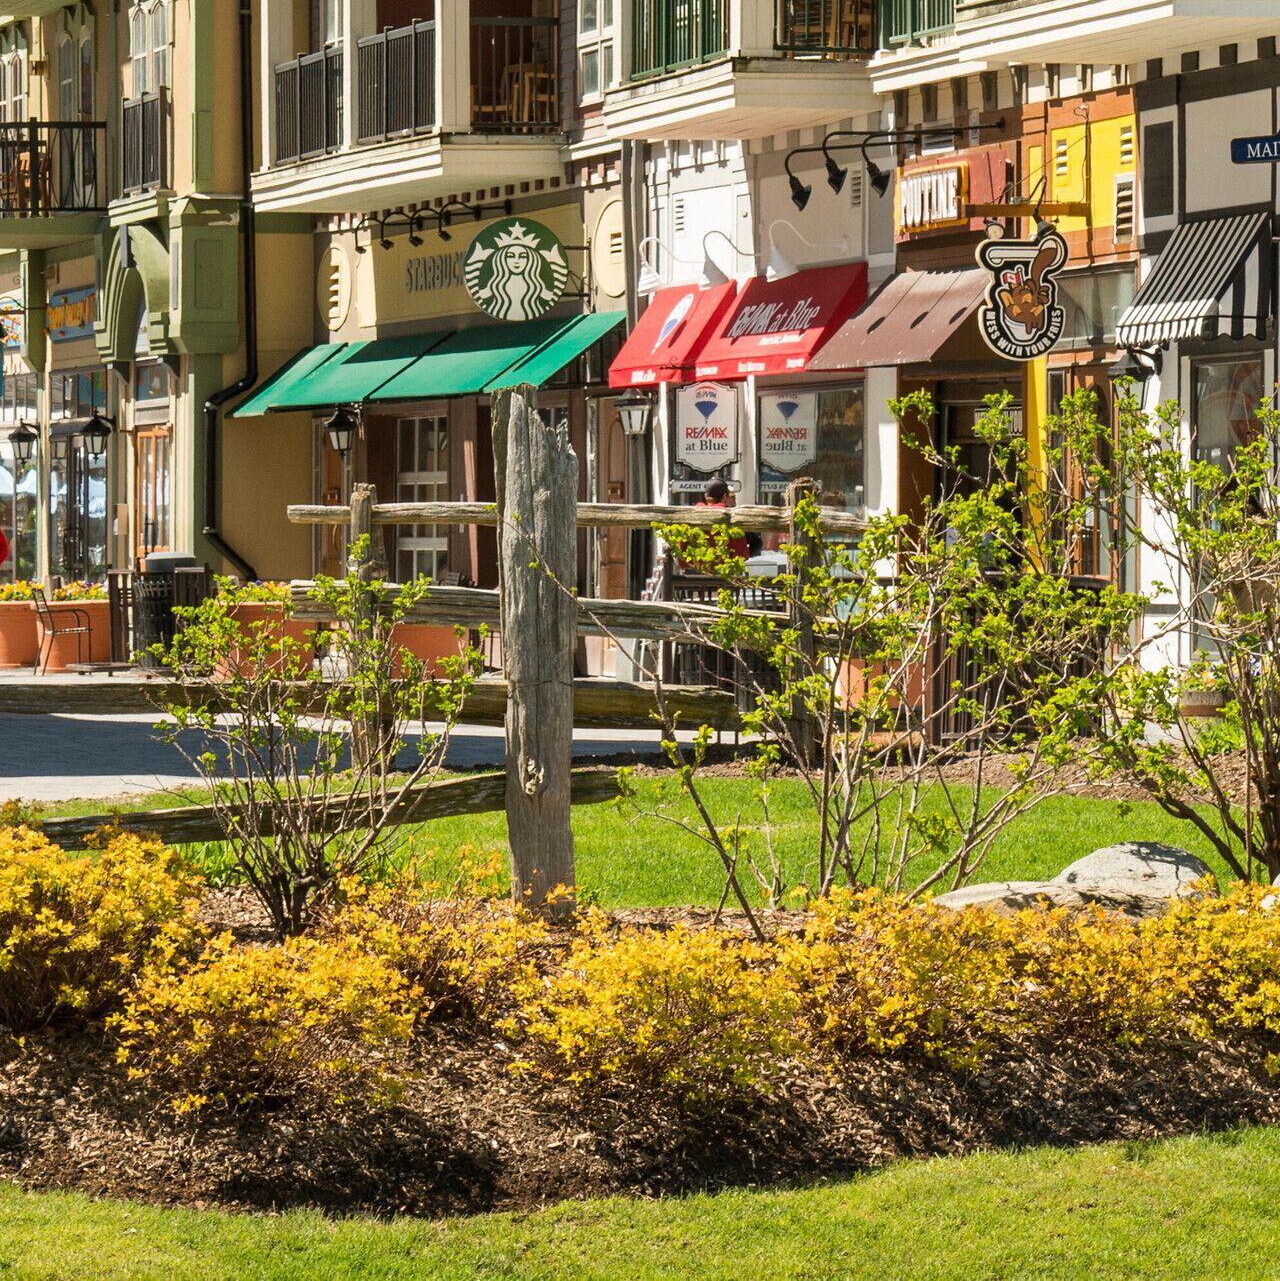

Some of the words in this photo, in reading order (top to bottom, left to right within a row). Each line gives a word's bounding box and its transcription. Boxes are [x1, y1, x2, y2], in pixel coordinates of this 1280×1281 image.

[900, 168, 958, 226] POUTINE
[768, 308, 789, 334] at
[780, 296, 821, 331] Blue
[986, 311, 1000, 340] MESS
[997, 337, 1023, 356] WITH
[1025, 338, 1051, 356] YOUR
[1049, 310, 1061, 338] FRIES
[686, 427, 728, 439] RE/MAX
[686, 442, 696, 451] at
[700, 439, 728, 451] Blue
